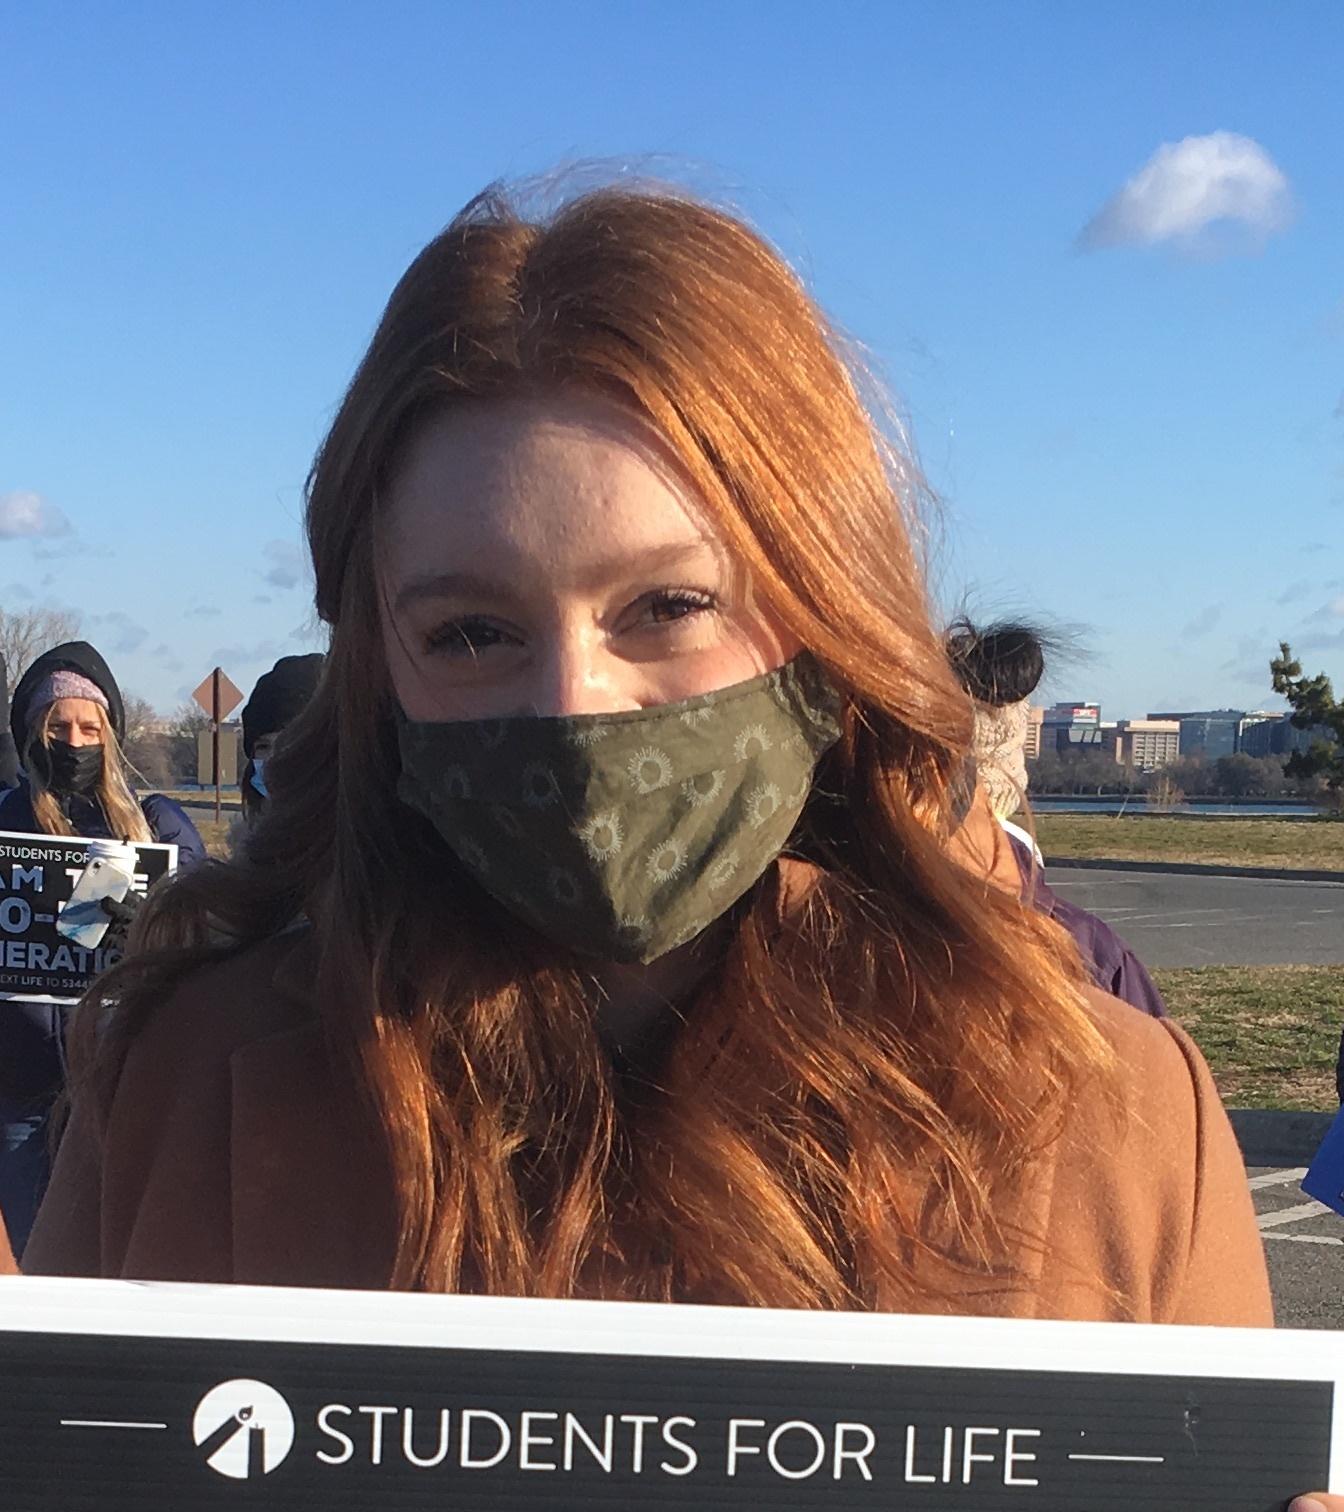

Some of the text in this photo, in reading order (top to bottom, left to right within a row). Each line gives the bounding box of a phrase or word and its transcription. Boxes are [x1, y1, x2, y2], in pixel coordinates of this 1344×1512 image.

[21, 975, 43, 987] LIFE
[46, 977, 60, 988] TO
[315, 1404, 1042, 1487] STUDENTS FOR LIFE
